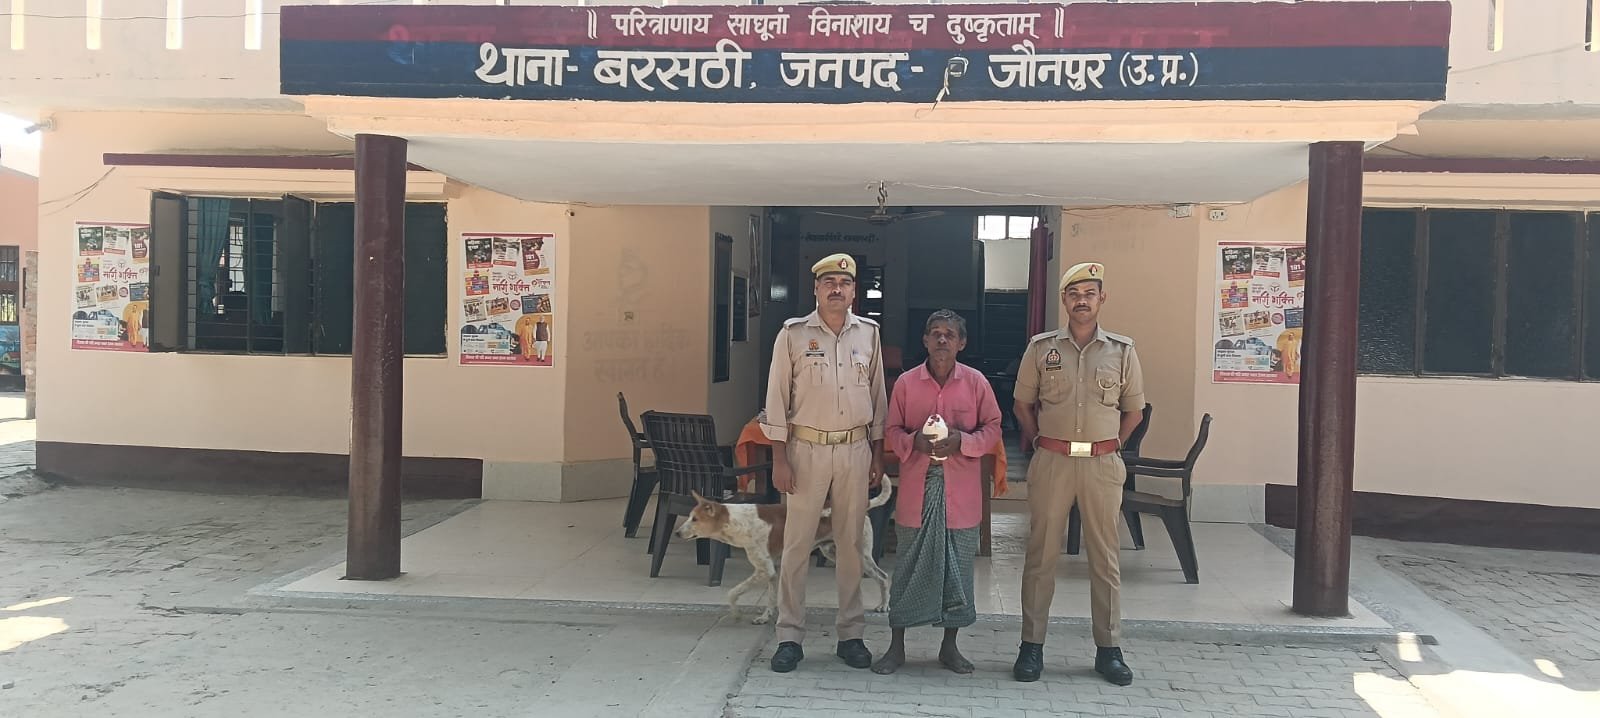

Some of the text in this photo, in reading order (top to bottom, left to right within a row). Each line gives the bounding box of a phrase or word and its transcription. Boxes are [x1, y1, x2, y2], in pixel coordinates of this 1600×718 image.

[610, 8, 714, 37] परित्राणाय
[726, 7, 792, 42] साधूनां
[807, 6, 893, 38] विनाशाय
[907, 13, 936, 36] च
[946, 12, 1042, 45] दुष्कृताम्
[987, 38, 1113, 92] जौनपुर
